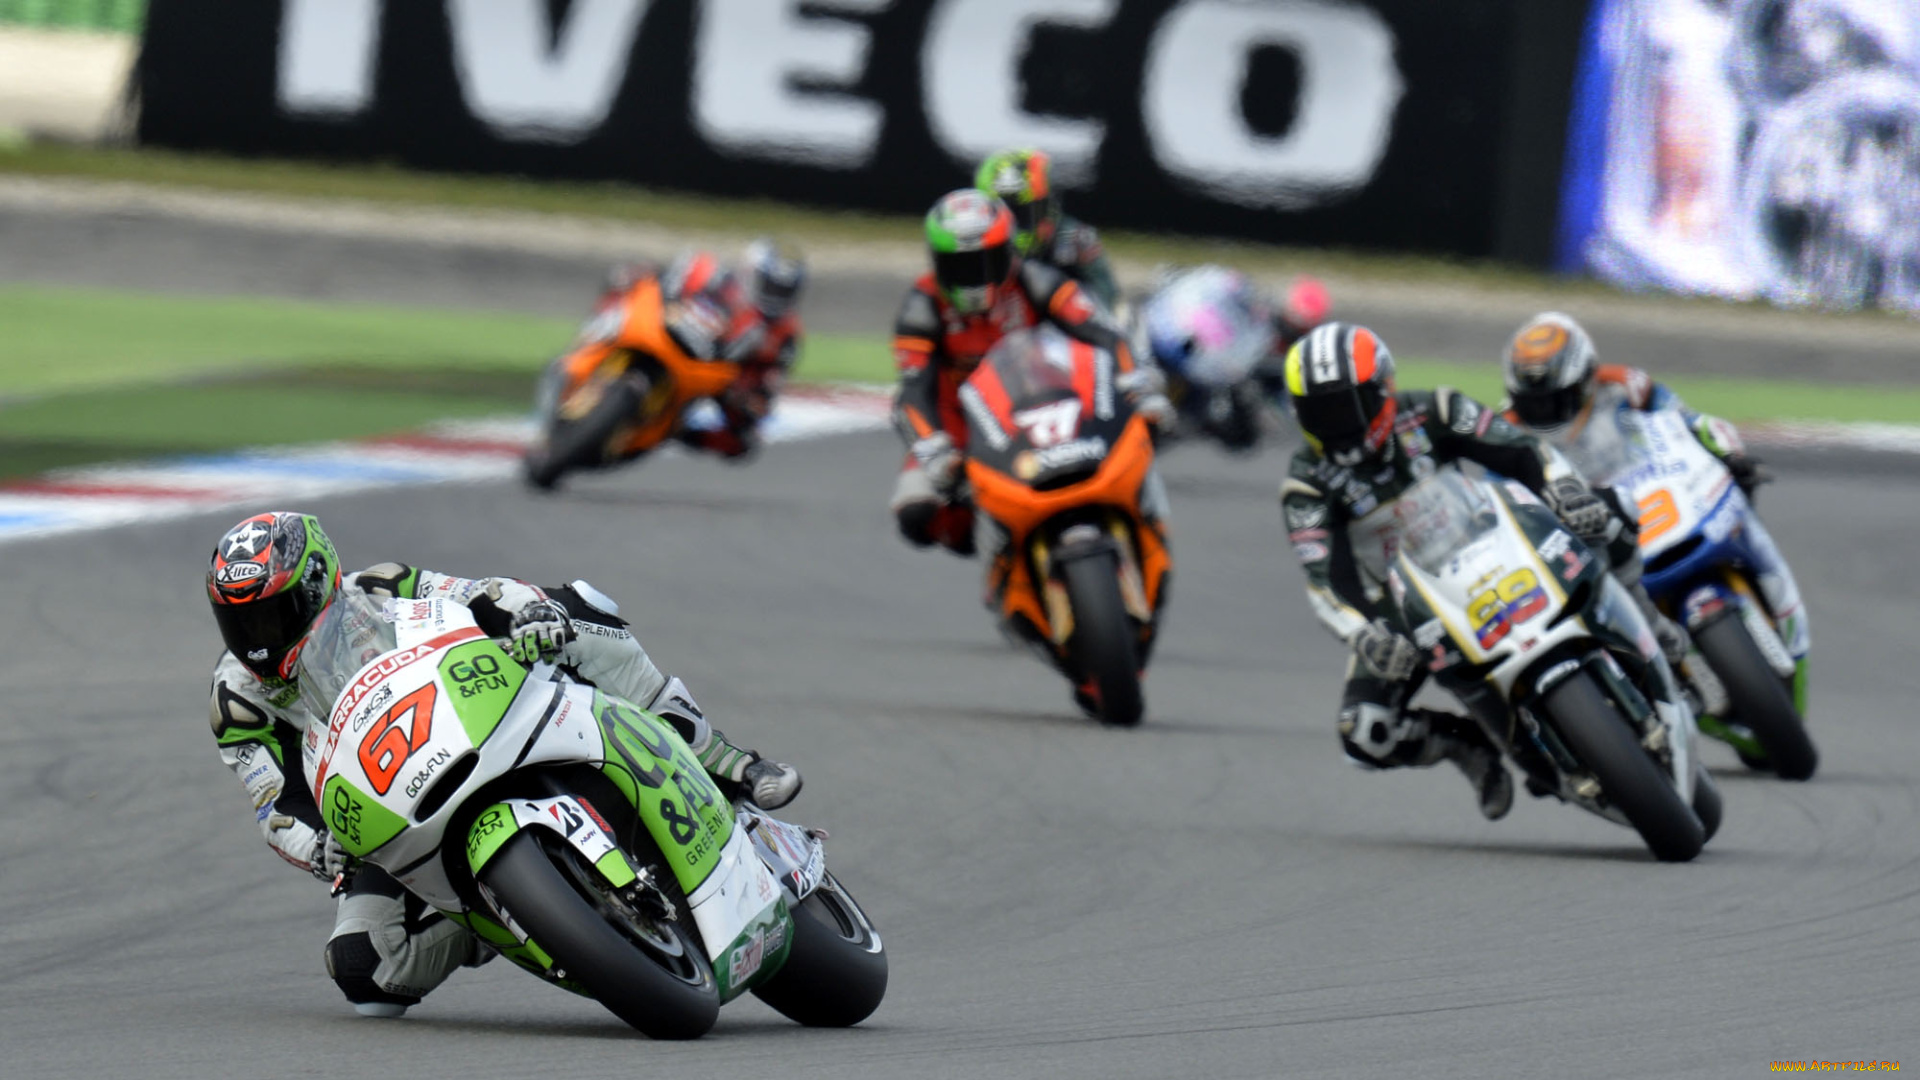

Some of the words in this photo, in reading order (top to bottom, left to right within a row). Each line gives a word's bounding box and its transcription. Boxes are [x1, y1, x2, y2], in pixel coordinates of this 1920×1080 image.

[274, 0, 1403, 203] IVECO
[220, 564, 259, 582] X-lite
[448, 654, 499, 683] GO
[459, 674, 509, 698] &FUN
[323, 643, 436, 765] BARRACUDA
[357, 680, 438, 797] 67
[405, 747, 452, 799] GO&FUN
[332, 785, 351, 835] GO
